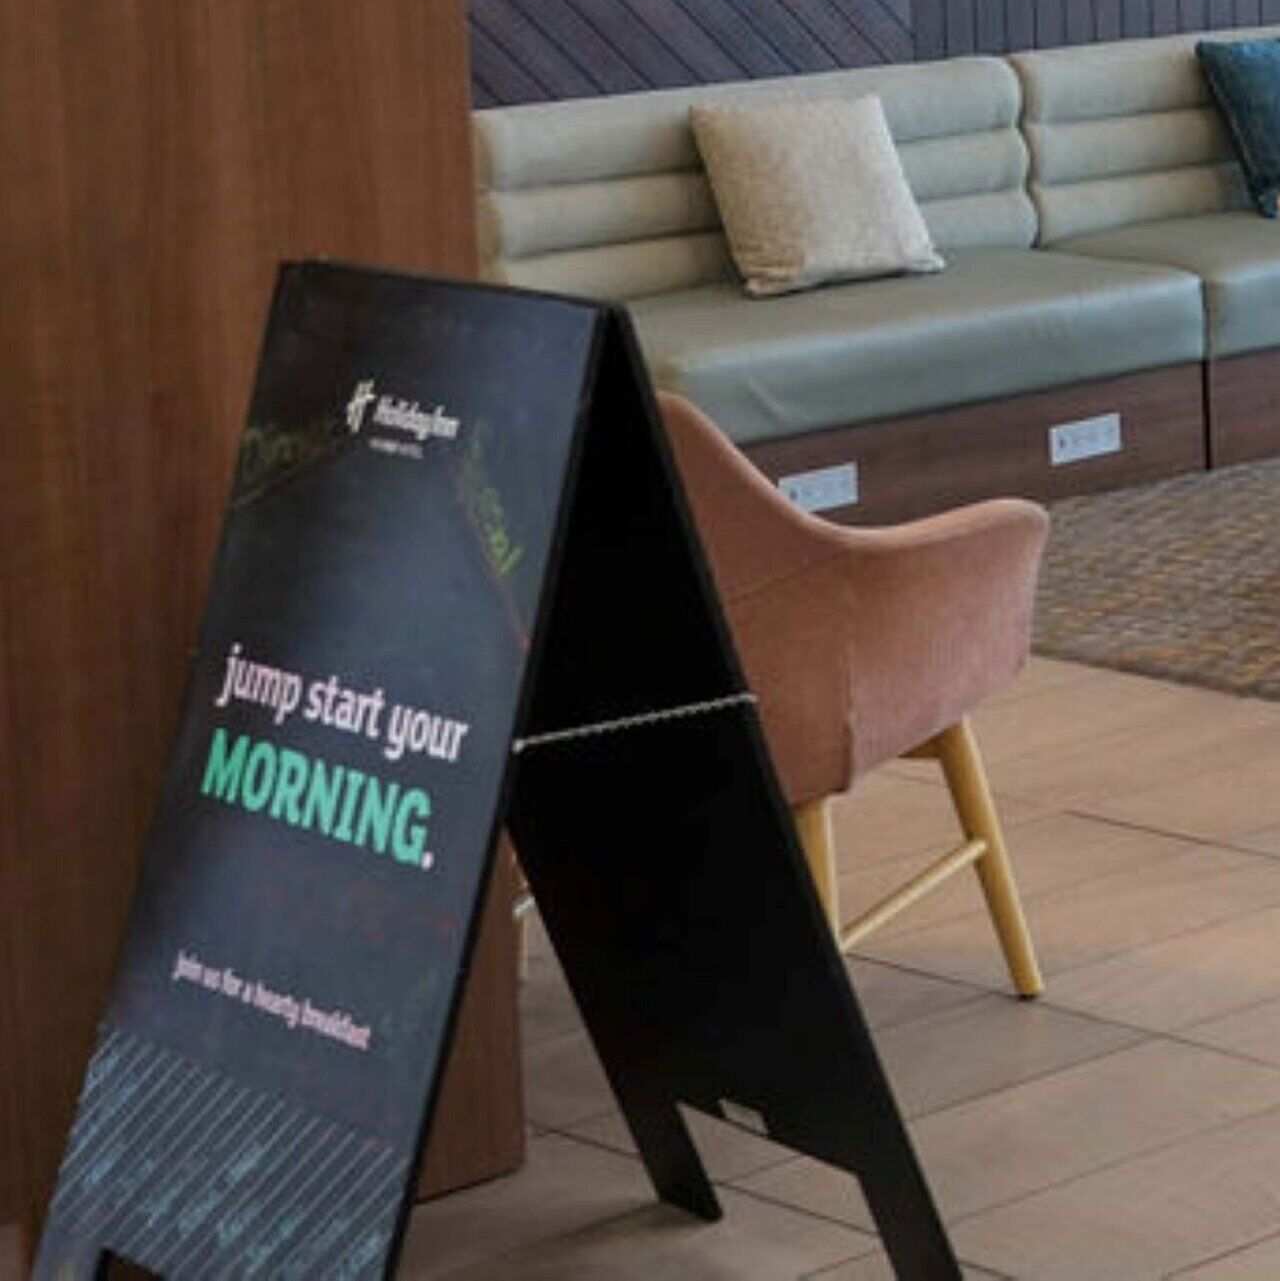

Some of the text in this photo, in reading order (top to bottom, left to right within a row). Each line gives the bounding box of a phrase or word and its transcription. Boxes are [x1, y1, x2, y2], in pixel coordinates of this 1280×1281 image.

[215, 641, 468, 762] jump start your
[203, 727, 435, 869] MORNING.
